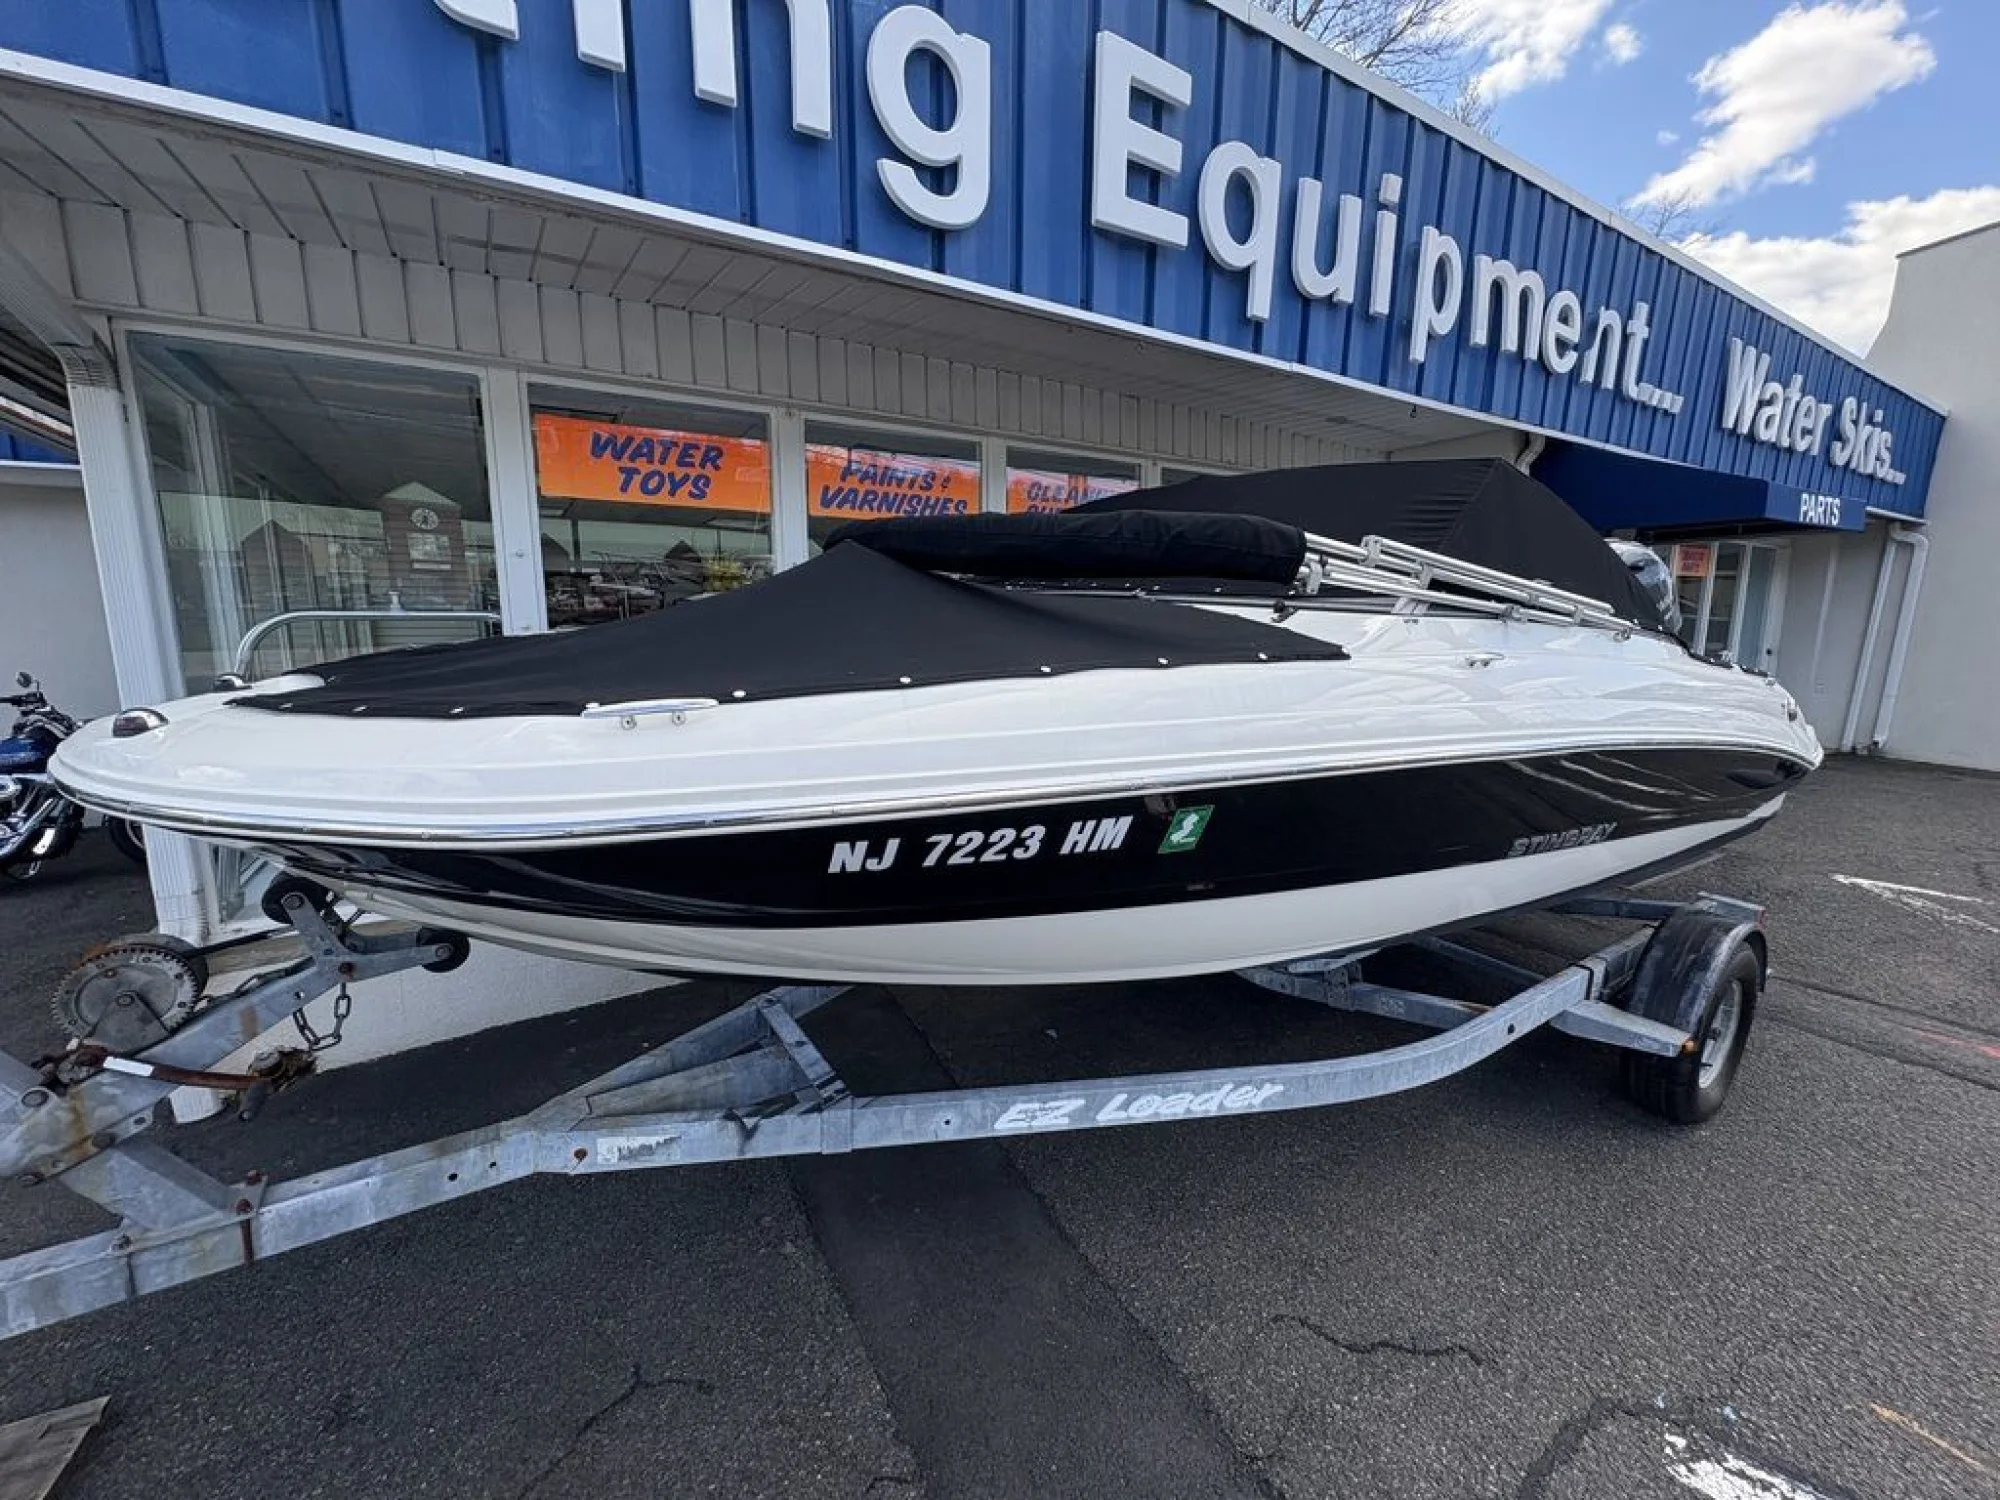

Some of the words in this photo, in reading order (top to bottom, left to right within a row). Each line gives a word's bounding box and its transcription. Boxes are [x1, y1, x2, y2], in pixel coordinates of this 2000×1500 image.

[1722, 337, 1833, 456] Water
[590, 431, 724, 471] WATER
[617, 466, 711, 500] TOYS
[840, 463, 936, 491] PAINTS
[819, 484, 968, 515] VARNISHES
[1799, 492, 1841, 526] PARTS
[828, 838, 900, 873] NJ
[922, 824, 1046, 867] 7223
[1058, 815, 1134, 854] HM
[1508, 822, 1618, 857] STINGRAY
[993, 1099, 1086, 1130] EZ
[1095, 1083, 1284, 1123] Loader
